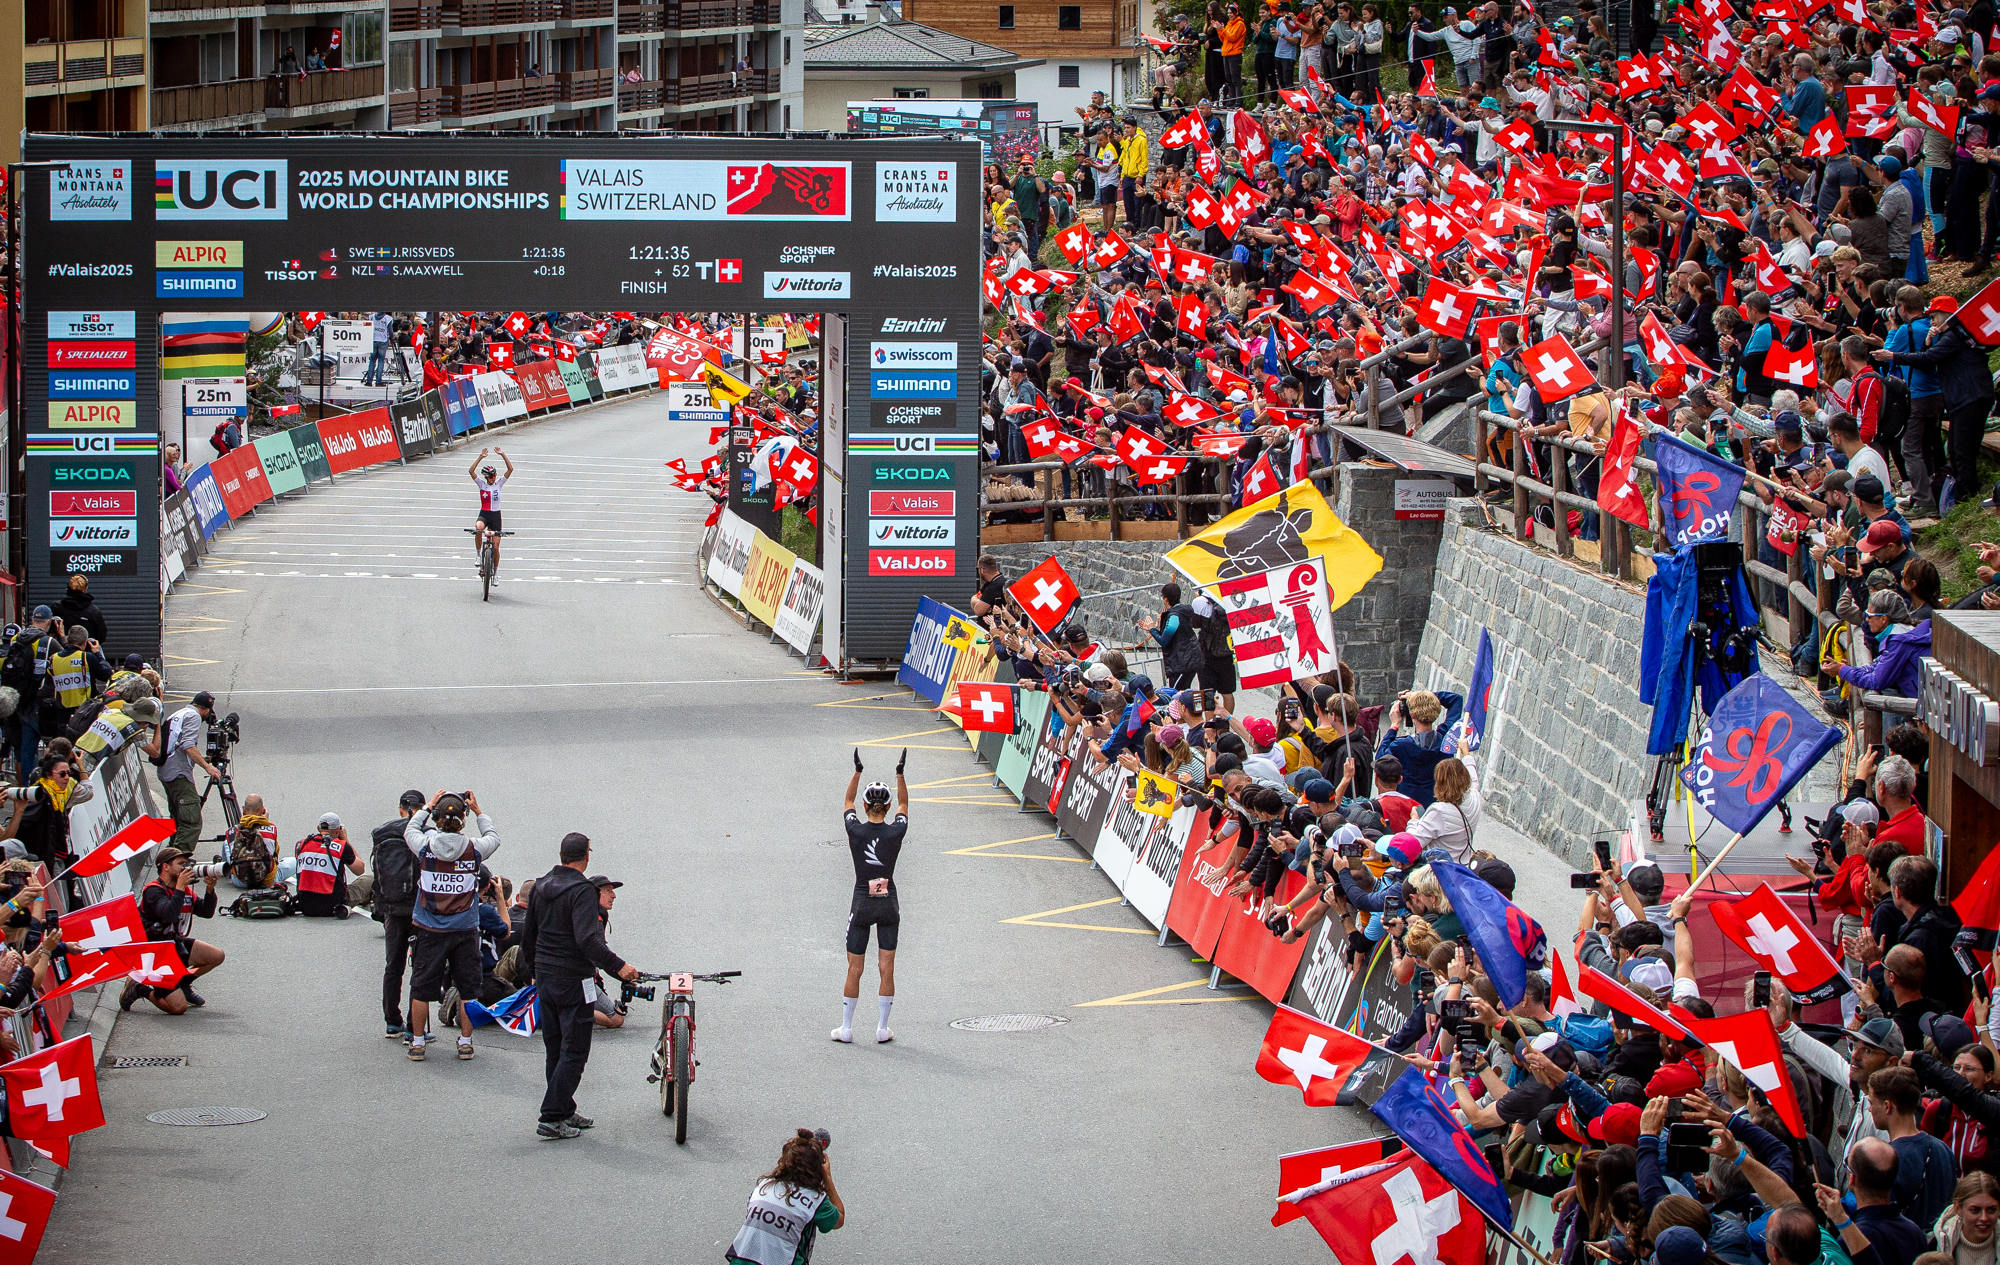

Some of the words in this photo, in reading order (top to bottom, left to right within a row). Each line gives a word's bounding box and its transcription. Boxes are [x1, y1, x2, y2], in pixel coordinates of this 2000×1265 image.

[883, 115, 900, 123] UCI
[1016, 110, 1031, 118] RTS
[58, 168, 102, 179] CRANS
[299, 171, 343, 187] 2025
[348, 170, 459, 187] MOUNTAIN
[465, 170, 508, 186] BIKE
[576, 169, 644, 186] VALAIS
[884, 170, 927, 180] CRANS
[58, 181, 123, 191] MONTANA
[173, 170, 277, 210] UCI
[884, 183, 948, 193] MONTANA
[60, 193, 120, 211] Absolutely
[299, 193, 373, 209] WORLD
[378, 193, 550, 209] CHAMPIONSHIPS
[577, 193, 716, 210] SWITZERLAND
[886, 195, 944, 213] Absolutely
[173, 246, 227, 265] ALPIQ
[330, 248, 337, 257] 1
[349, 248, 375, 258] SWE
[393, 248, 455, 258] J.RISSVEDS
[522, 247, 565, 258] 1:21:35
[629, 246, 690, 260] 1:21:35
[783, 246, 835, 255] OCHSNER
[780, 255, 816, 263] SPORT
[48, 263, 133, 276] #Valais2025
[265, 270, 317, 281] TISSOT
[330, 266, 337, 276] 2
[352, 266, 375, 276] NZL
[393, 266, 464, 276] S.MAXWELL
[533, 265, 565, 276] +0:18
[672, 265, 690, 277] 52
[873, 264, 957, 277] #Valais2025
[163, 278, 236, 290] SHIMANO
[621, 282, 667, 294] FINISH
[790, 278, 843, 291] vittoria
[69, 323, 114, 332] TISSOT
[880, 317, 947, 333] Santini
[332, 329, 362, 341] 50m
[65, 350, 128, 359] SPECIALIZED
[890, 348, 952, 361] swisscom
[54, 379, 130, 390] SHIMANO
[877, 379, 951, 391] SHIMANO
[197, 389, 231, 402] 25m
[64, 405, 121, 423] ALPIQ
[192, 407, 236, 415] SHIMANO
[678, 412, 723, 420] SHIMANO
[889, 406, 941, 415] OCHSNER
[886, 415, 922, 424] SPORT
[401, 411, 431, 444] Santini
[357, 424, 393, 448] ValJob
[74, 437, 110, 451] UCI
[325, 432, 357, 456] ValJob
[894, 437, 930, 451] UCI
[84, 497, 120, 508] Valais
[902, 497, 938, 508] Valais
[75, 525, 130, 540] vittoria
[893, 526, 949, 539] vittoria
[69, 554, 122, 563] OCHSNER
[876, 556, 947, 569] ValJob
[66, 563, 103, 572] SPORT
[753, 556, 788, 619] ALPIQ
[904, 613, 948, 685] SHIMANO
[55, 676, 81, 691] PHOTO
[1067, 774, 1098, 822] SPORT
[330, 842, 340, 850] CI
[1147, 826, 1184, 887] vittoria
[459, 861, 475, 869] UCI
[432, 873, 465, 882] VIDEO
[431, 883, 464, 892] RADIO
[876, 884, 882, 892] 2
[1302, 916, 1354, 1025] Santini
[678, 977, 686, 987] 2
[790, 1189, 813, 1209] UCI
[751, 1206, 796, 1233] HOST
